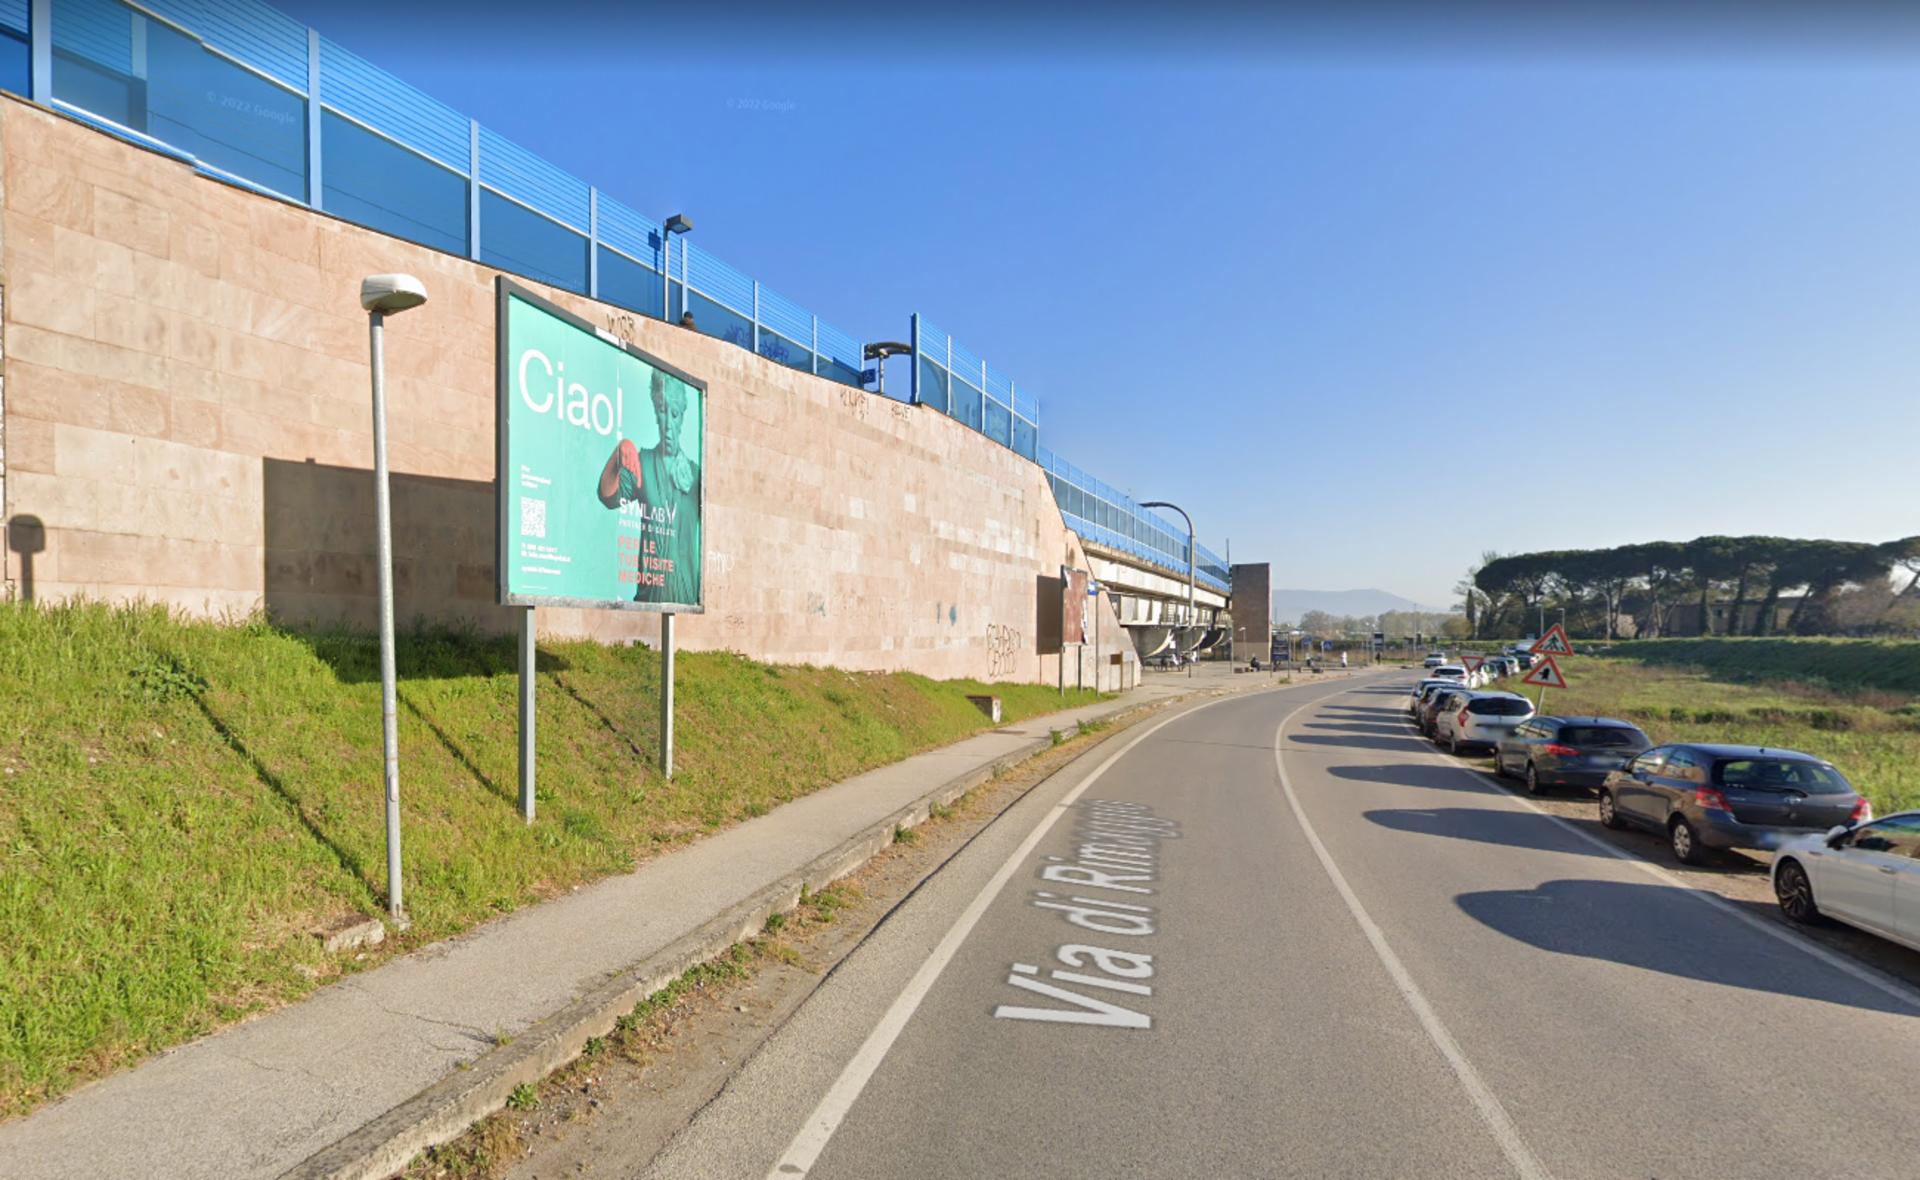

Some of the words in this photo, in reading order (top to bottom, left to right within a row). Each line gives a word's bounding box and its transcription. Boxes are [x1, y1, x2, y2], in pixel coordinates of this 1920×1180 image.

[518, 348, 623, 441] Ciao!
[643, 539, 656, 554] LE
[643, 556, 674, 572] VISITE
[618, 569, 665, 587] MEDICHE
